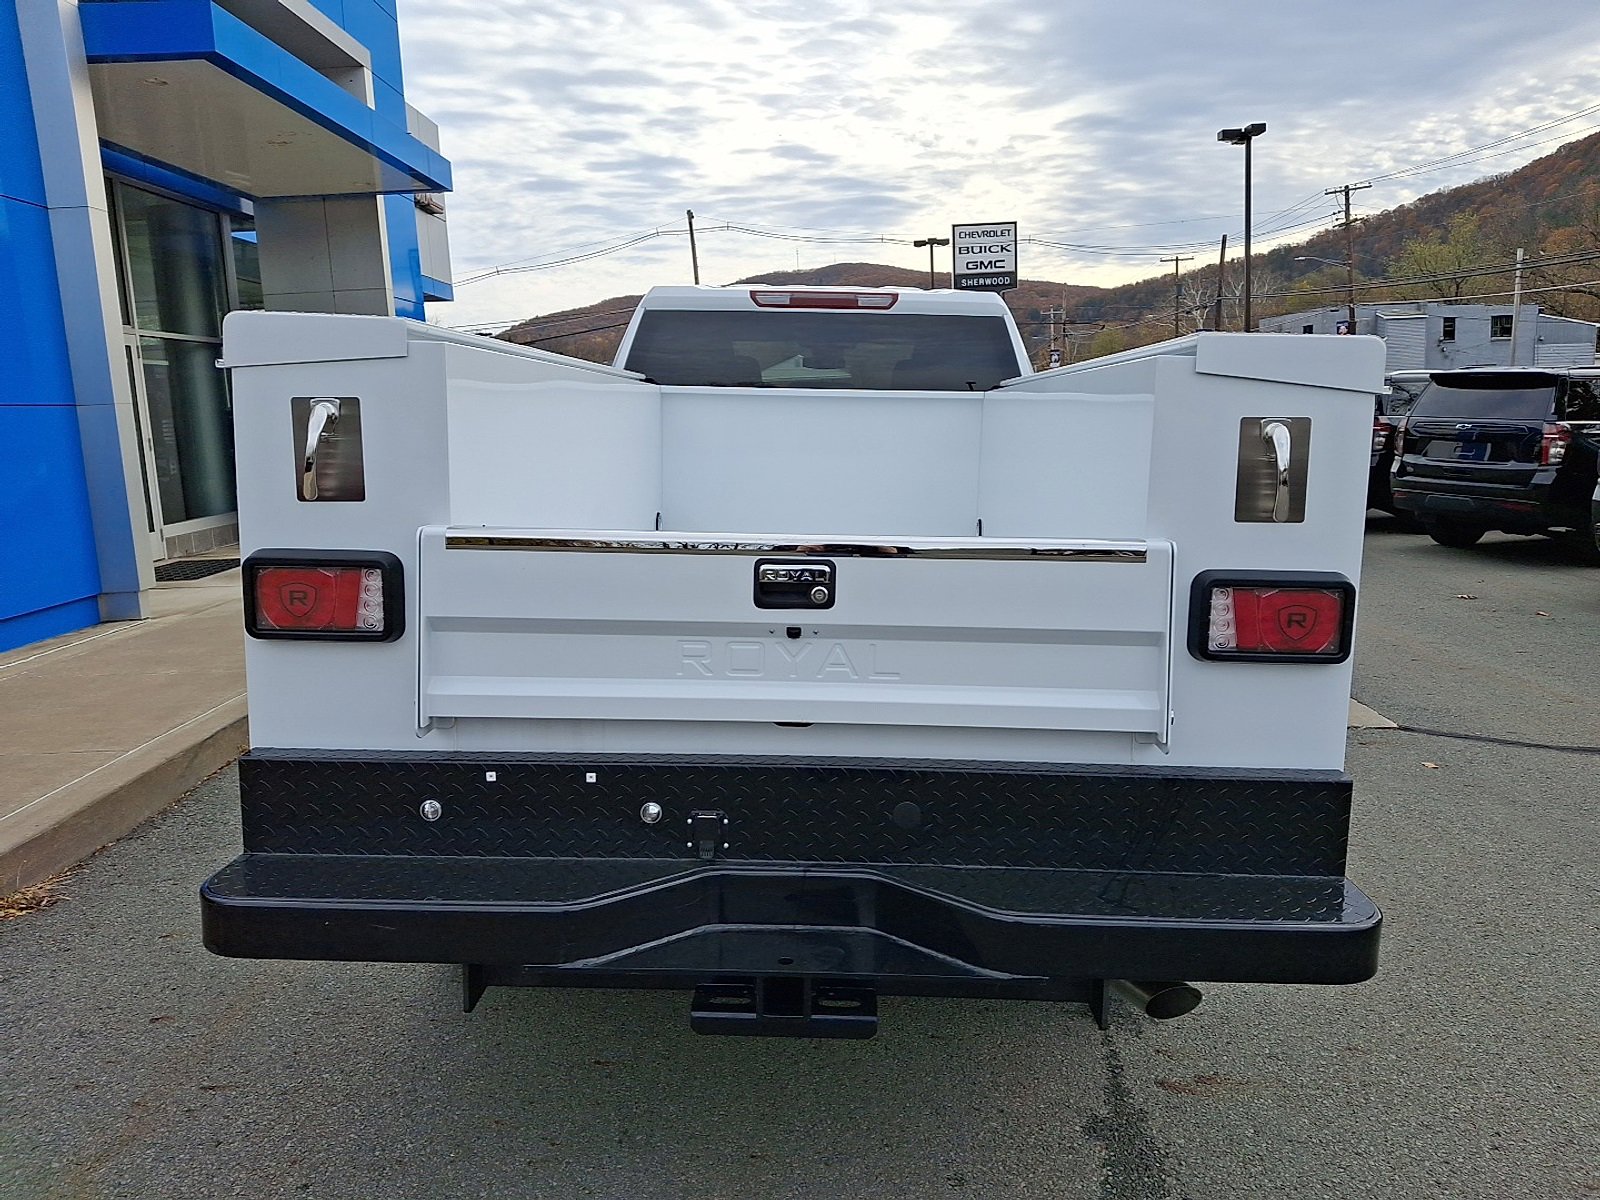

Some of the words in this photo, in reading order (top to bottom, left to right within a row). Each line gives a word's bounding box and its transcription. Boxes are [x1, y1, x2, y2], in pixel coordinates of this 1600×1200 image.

[958, 228, 1012, 239] CHEVROLET
[958, 244, 1012, 255] BUICK
[965, 259, 1006, 270] GMC
[961, 276, 1010, 287] SHERWOOD
[764, 570, 825, 581] ROYAL
[288, 590, 308, 606] R
[1287, 612, 1307, 628] R
[676, 639, 901, 680] ROYAL
